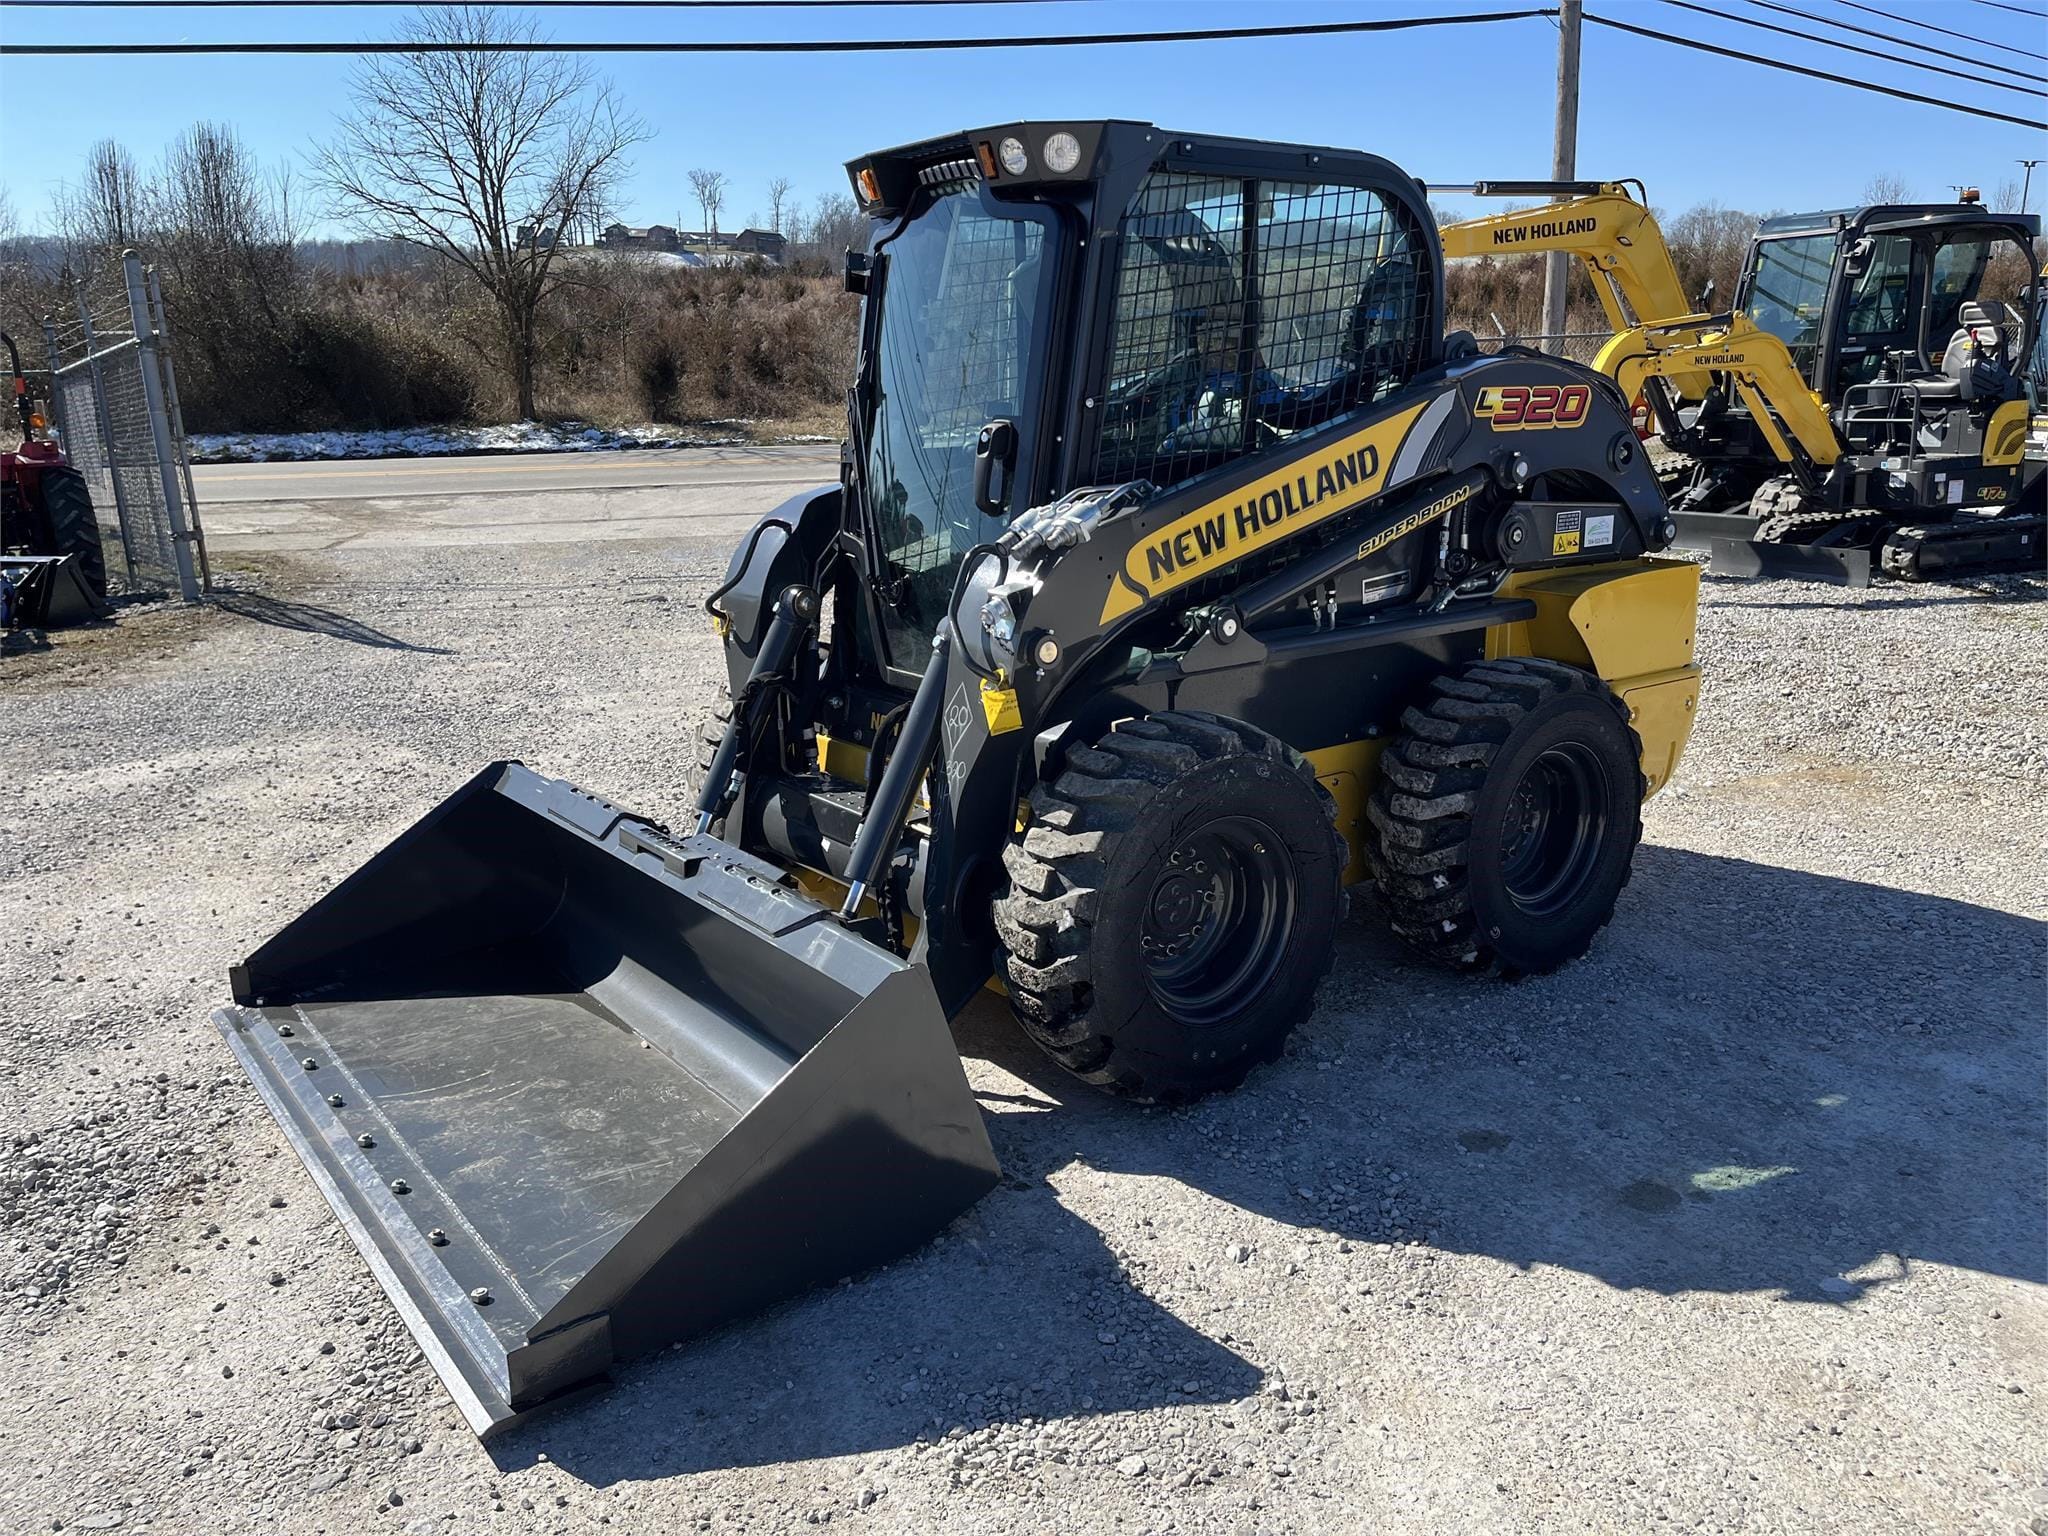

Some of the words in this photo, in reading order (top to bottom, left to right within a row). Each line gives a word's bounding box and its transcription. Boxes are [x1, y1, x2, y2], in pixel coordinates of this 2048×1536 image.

[1493, 226, 1528, 245] NEW
[1530, 217, 1597, 240] HOLLAND
[1694, 355, 1711, 365] NEW
[1712, 353, 1745, 364] HOLLAND
[1474, 385, 1592, 432] L320
[1145, 512, 1228, 583] NEW
[1233, 443, 1380, 541] HOLLAND
[1358, 513, 1419, 561] SUPER
[1418, 485, 1470, 526] BOOM
[949, 704, 969, 727] 20
